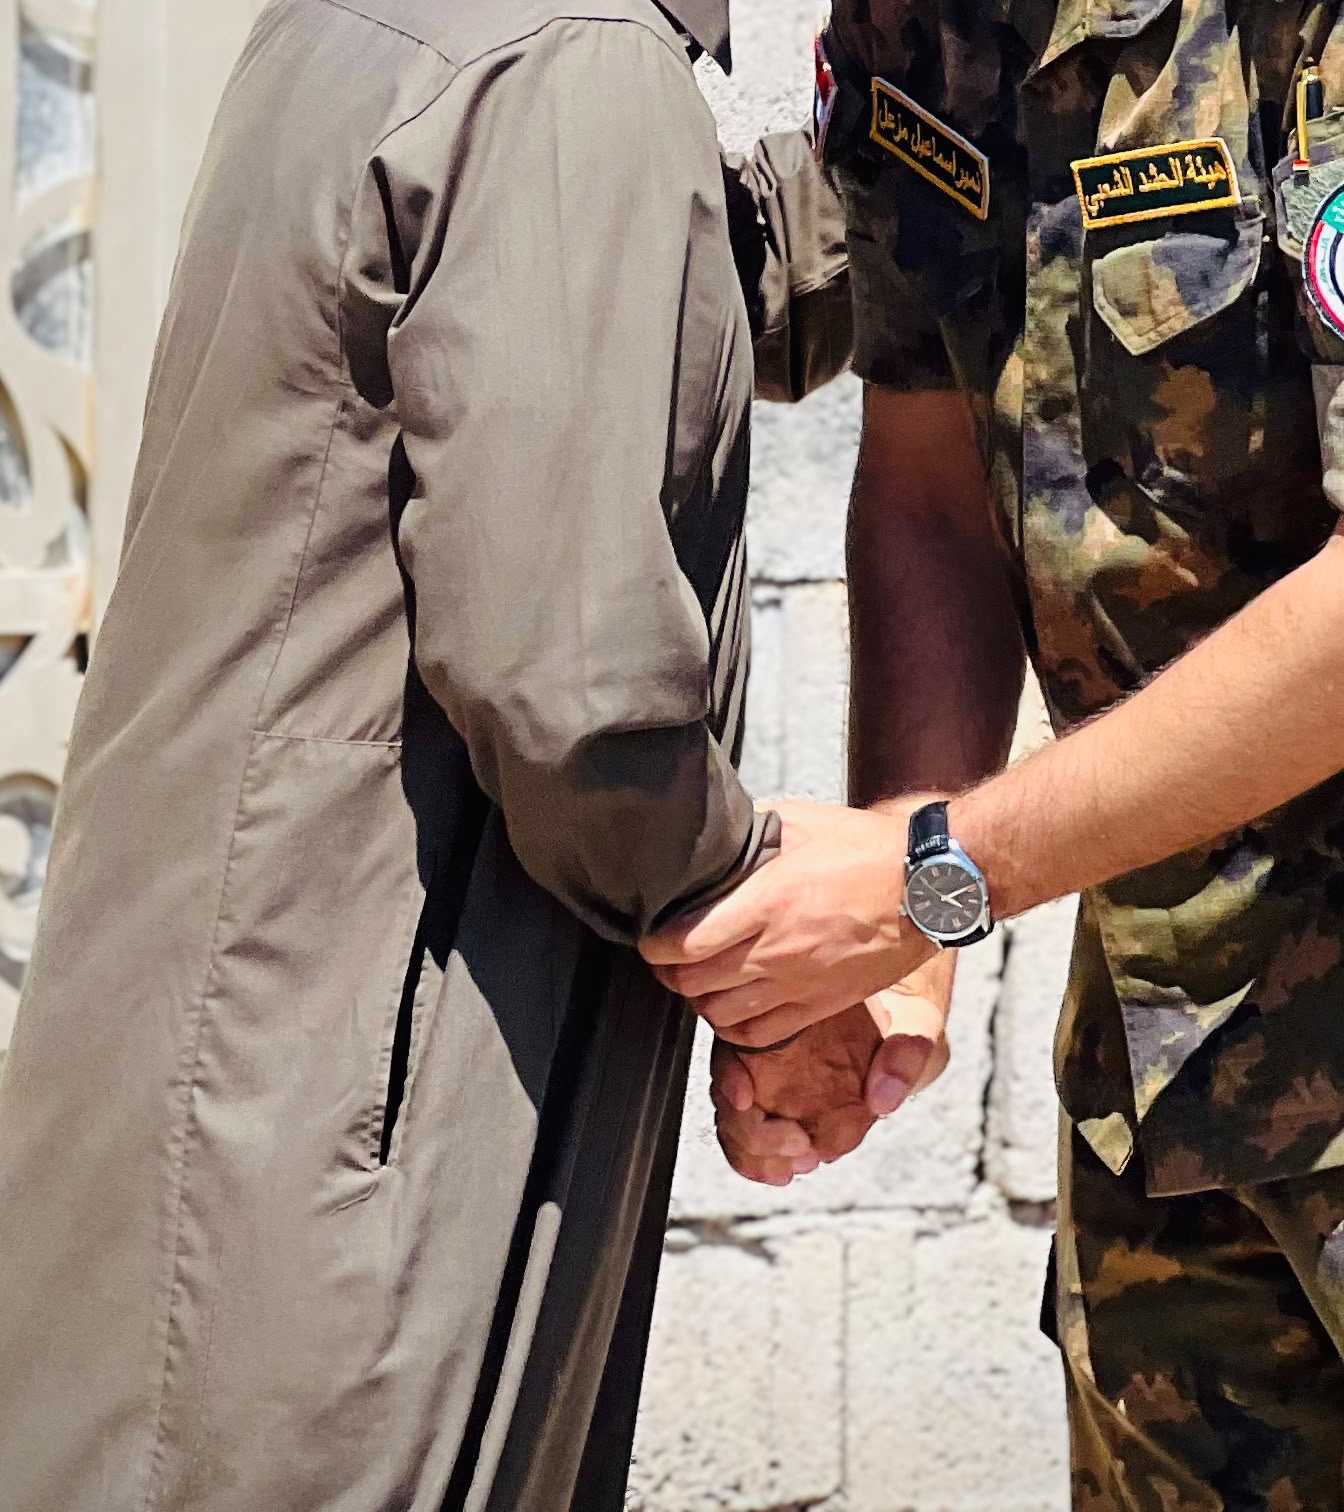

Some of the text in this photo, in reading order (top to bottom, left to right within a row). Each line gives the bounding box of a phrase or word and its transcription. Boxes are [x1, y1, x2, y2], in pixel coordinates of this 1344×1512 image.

[1085, 153, 1227, 217] هيئة الحشد الشعبي
